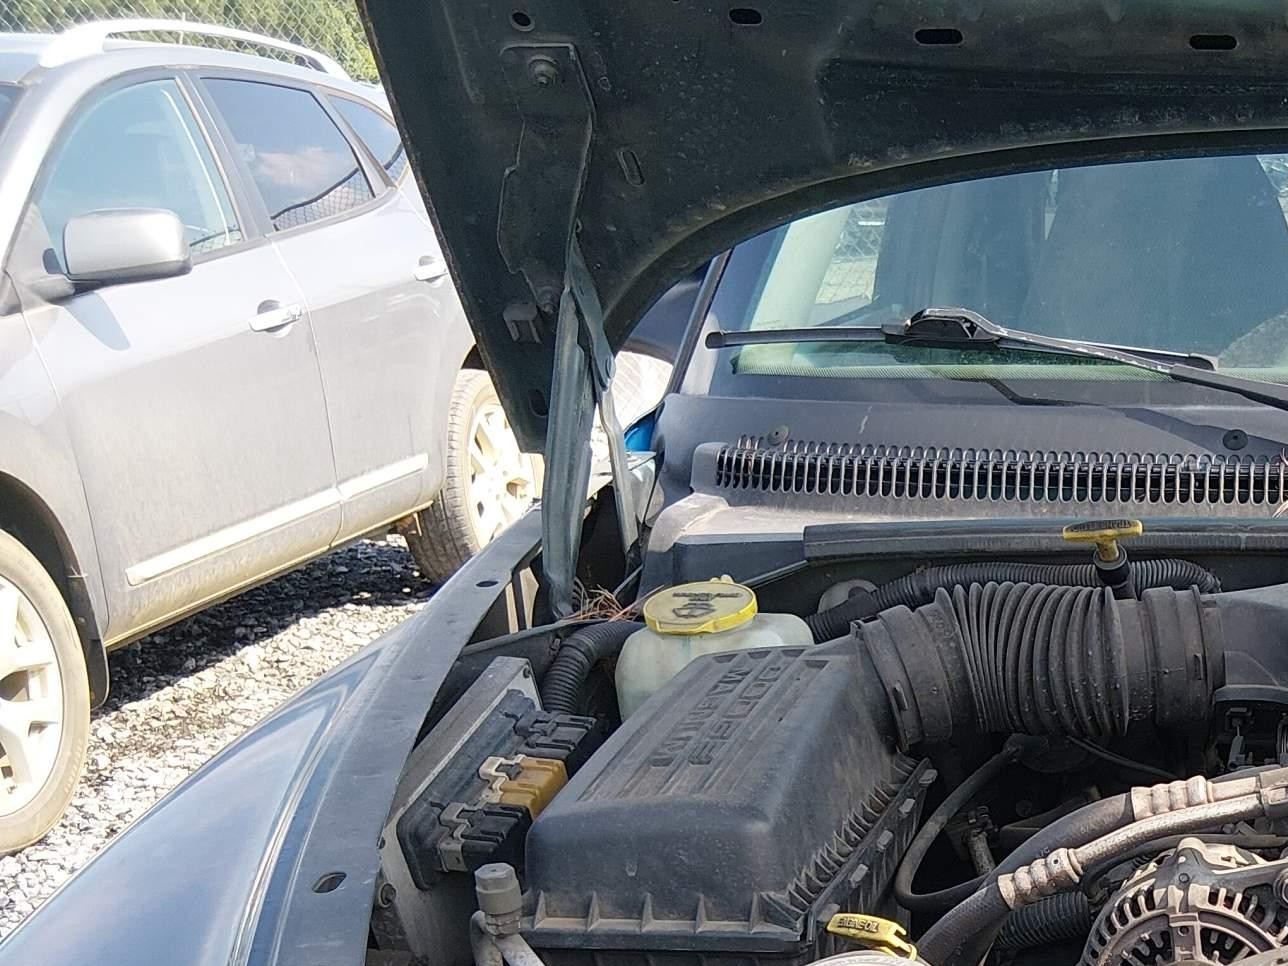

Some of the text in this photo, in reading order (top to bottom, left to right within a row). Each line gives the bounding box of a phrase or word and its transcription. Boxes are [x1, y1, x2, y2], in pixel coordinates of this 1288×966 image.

[648, 666, 754, 768] MAGNUM
[688, 664, 783, 766] DODGE
[864, 920, 880, 933] OIL
